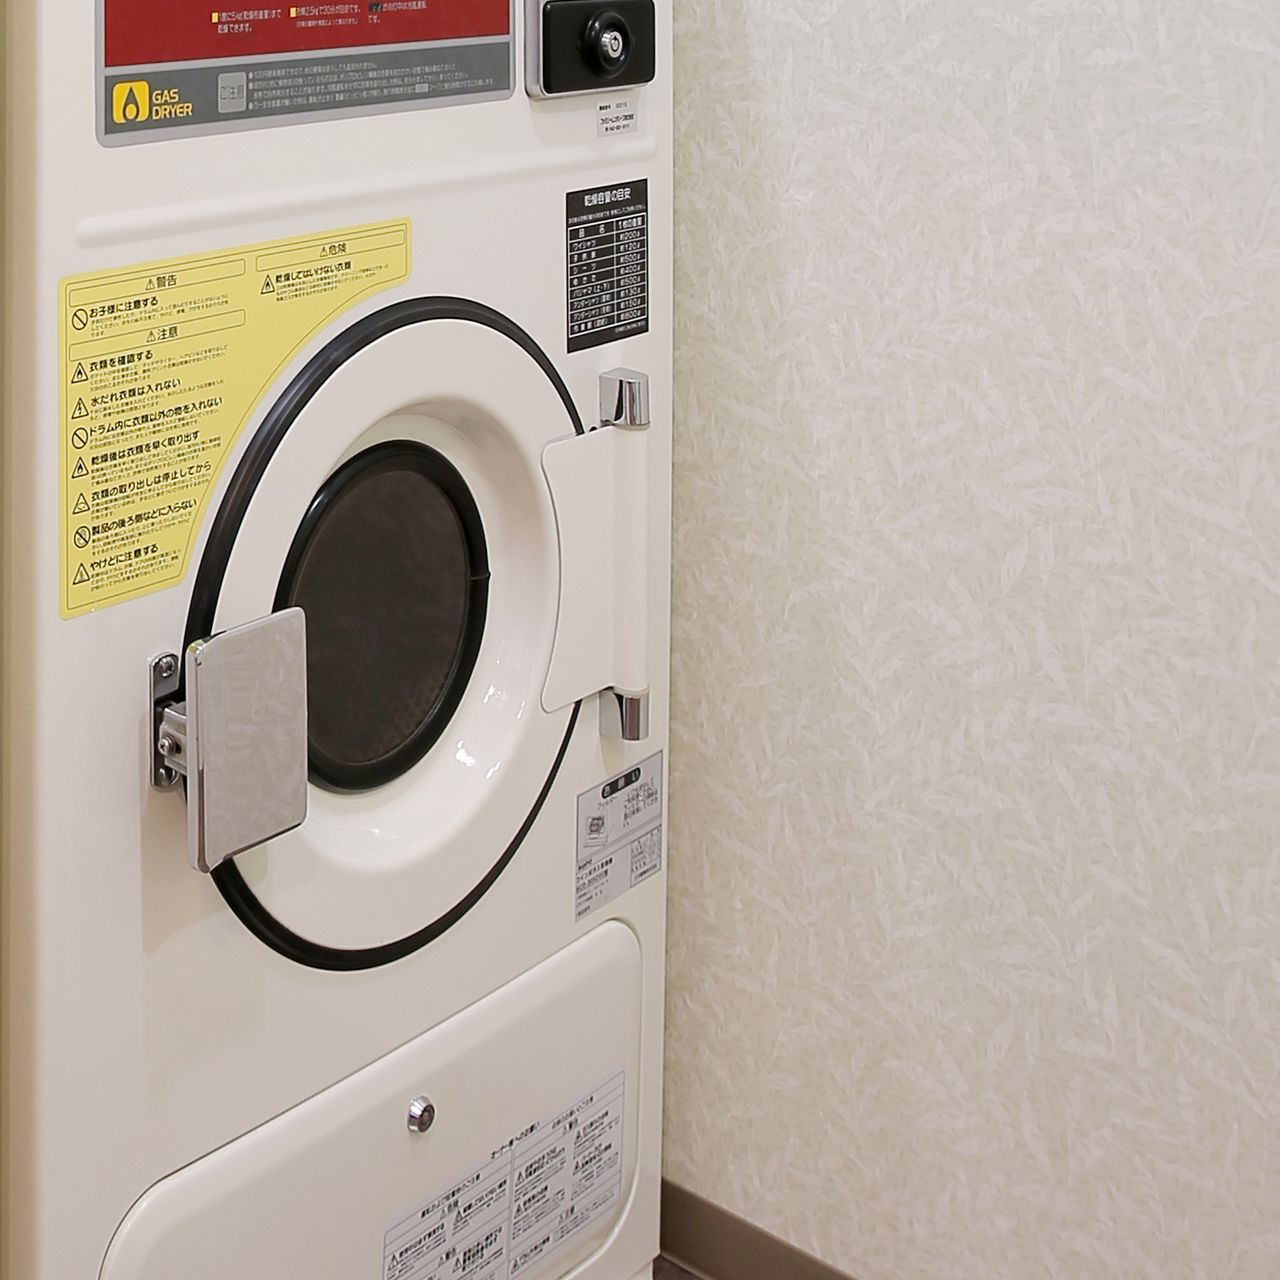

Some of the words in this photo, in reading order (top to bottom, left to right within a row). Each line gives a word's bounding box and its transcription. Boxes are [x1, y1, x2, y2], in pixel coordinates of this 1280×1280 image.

[152, 89, 179, 103] GAS
[152, 103, 192, 120] DRYER
[329, 243, 347, 256] 危険
[156, 274, 178, 289] 警告
[89, 296, 159, 318] お子様に注意する
[157, 326, 179, 341] 注意
[89, 350, 154, 372] 衣類を確認する
[91, 378, 181, 407] 水だれ衣類は入れない
[89, 396, 223, 437] ドラム内に衣類以外の物を入れない
[91, 430, 200, 466] 乾燥後は衣類を早く取り出す
[91, 461, 212, 502] 衣類の取り出しは停止してから
[90, 544, 159, 571] やけどに注意する
